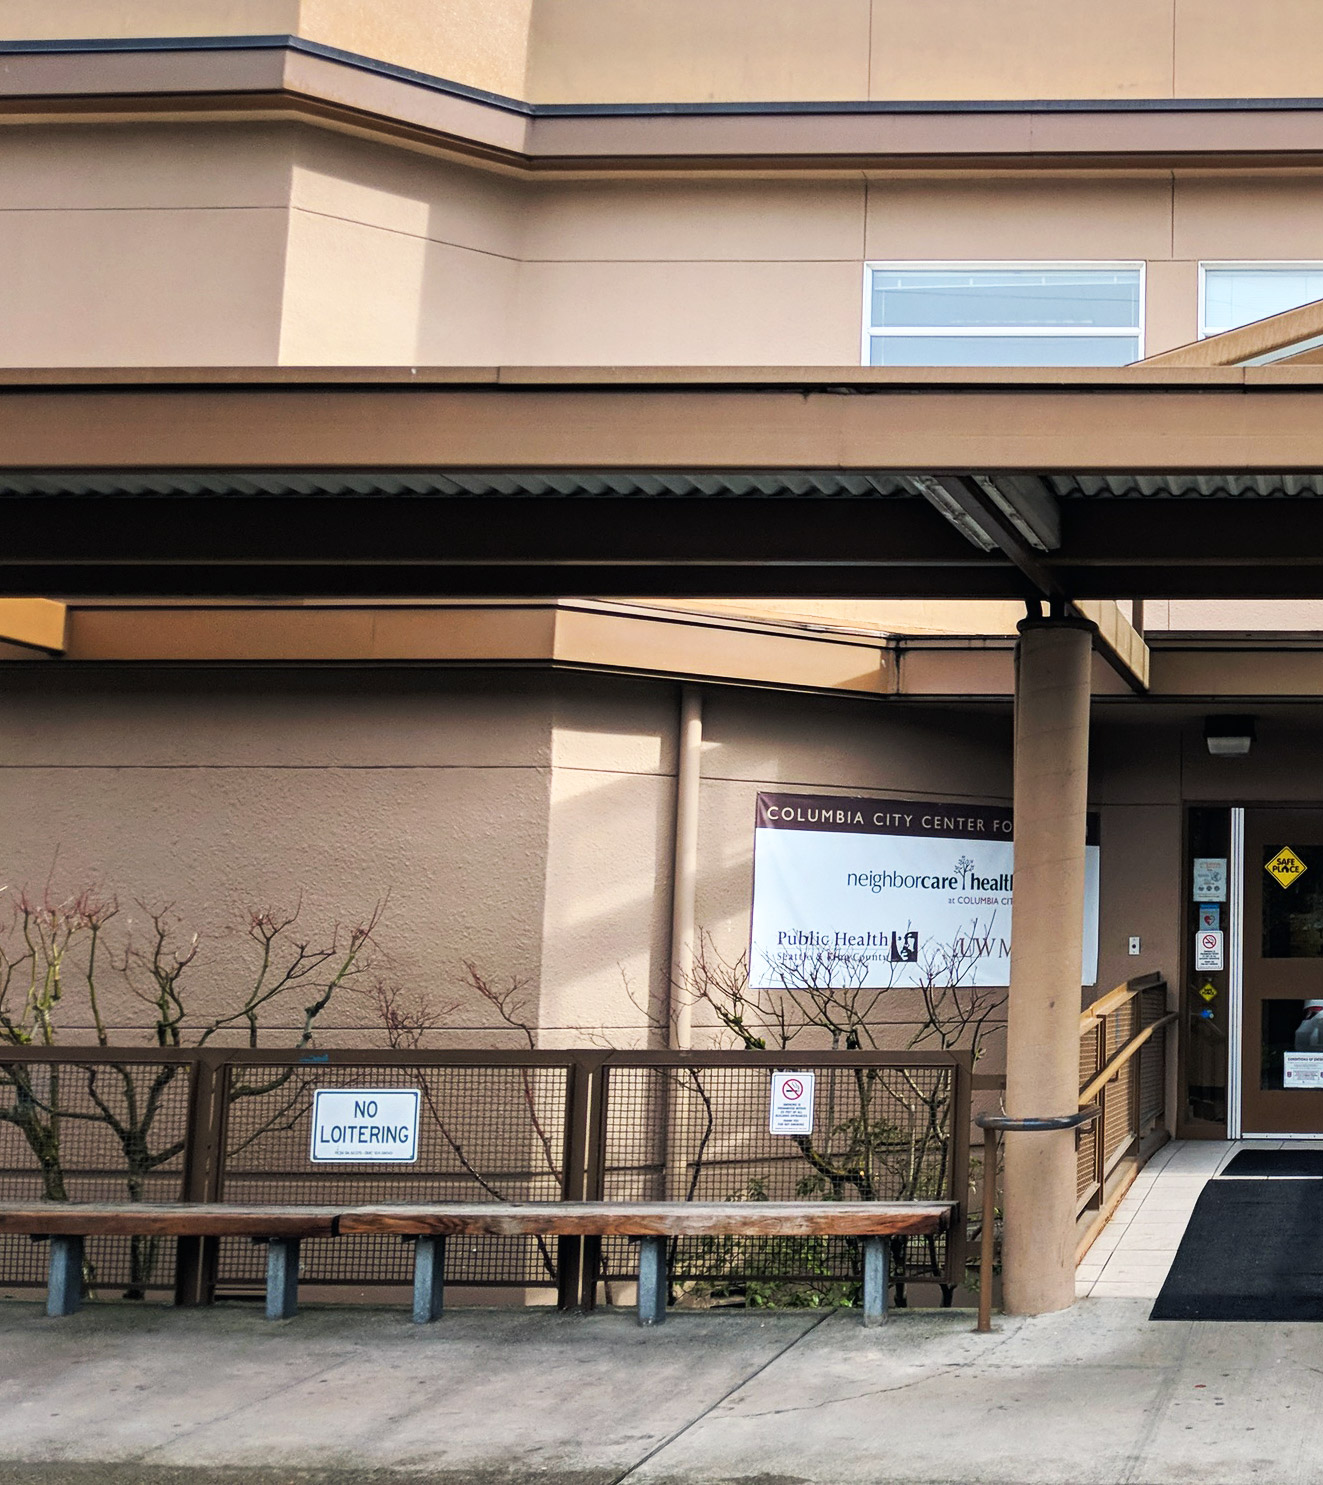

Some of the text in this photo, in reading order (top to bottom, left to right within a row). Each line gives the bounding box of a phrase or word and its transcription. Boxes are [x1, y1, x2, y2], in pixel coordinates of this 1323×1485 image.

[767, 806, 865, 825] COLUMBIA
[873, 812, 913, 828] CITY
[921, 815, 985, 832] CENTER
[1276, 857, 1295, 866] SAFE
[847, 870, 958, 894] neighborcare
[957, 896, 999, 906] COLUMBIA
[777, 931, 888, 947] Public Health
[354, 1100, 378, 1118] NO
[320, 1125, 409, 1144] LOITERING
